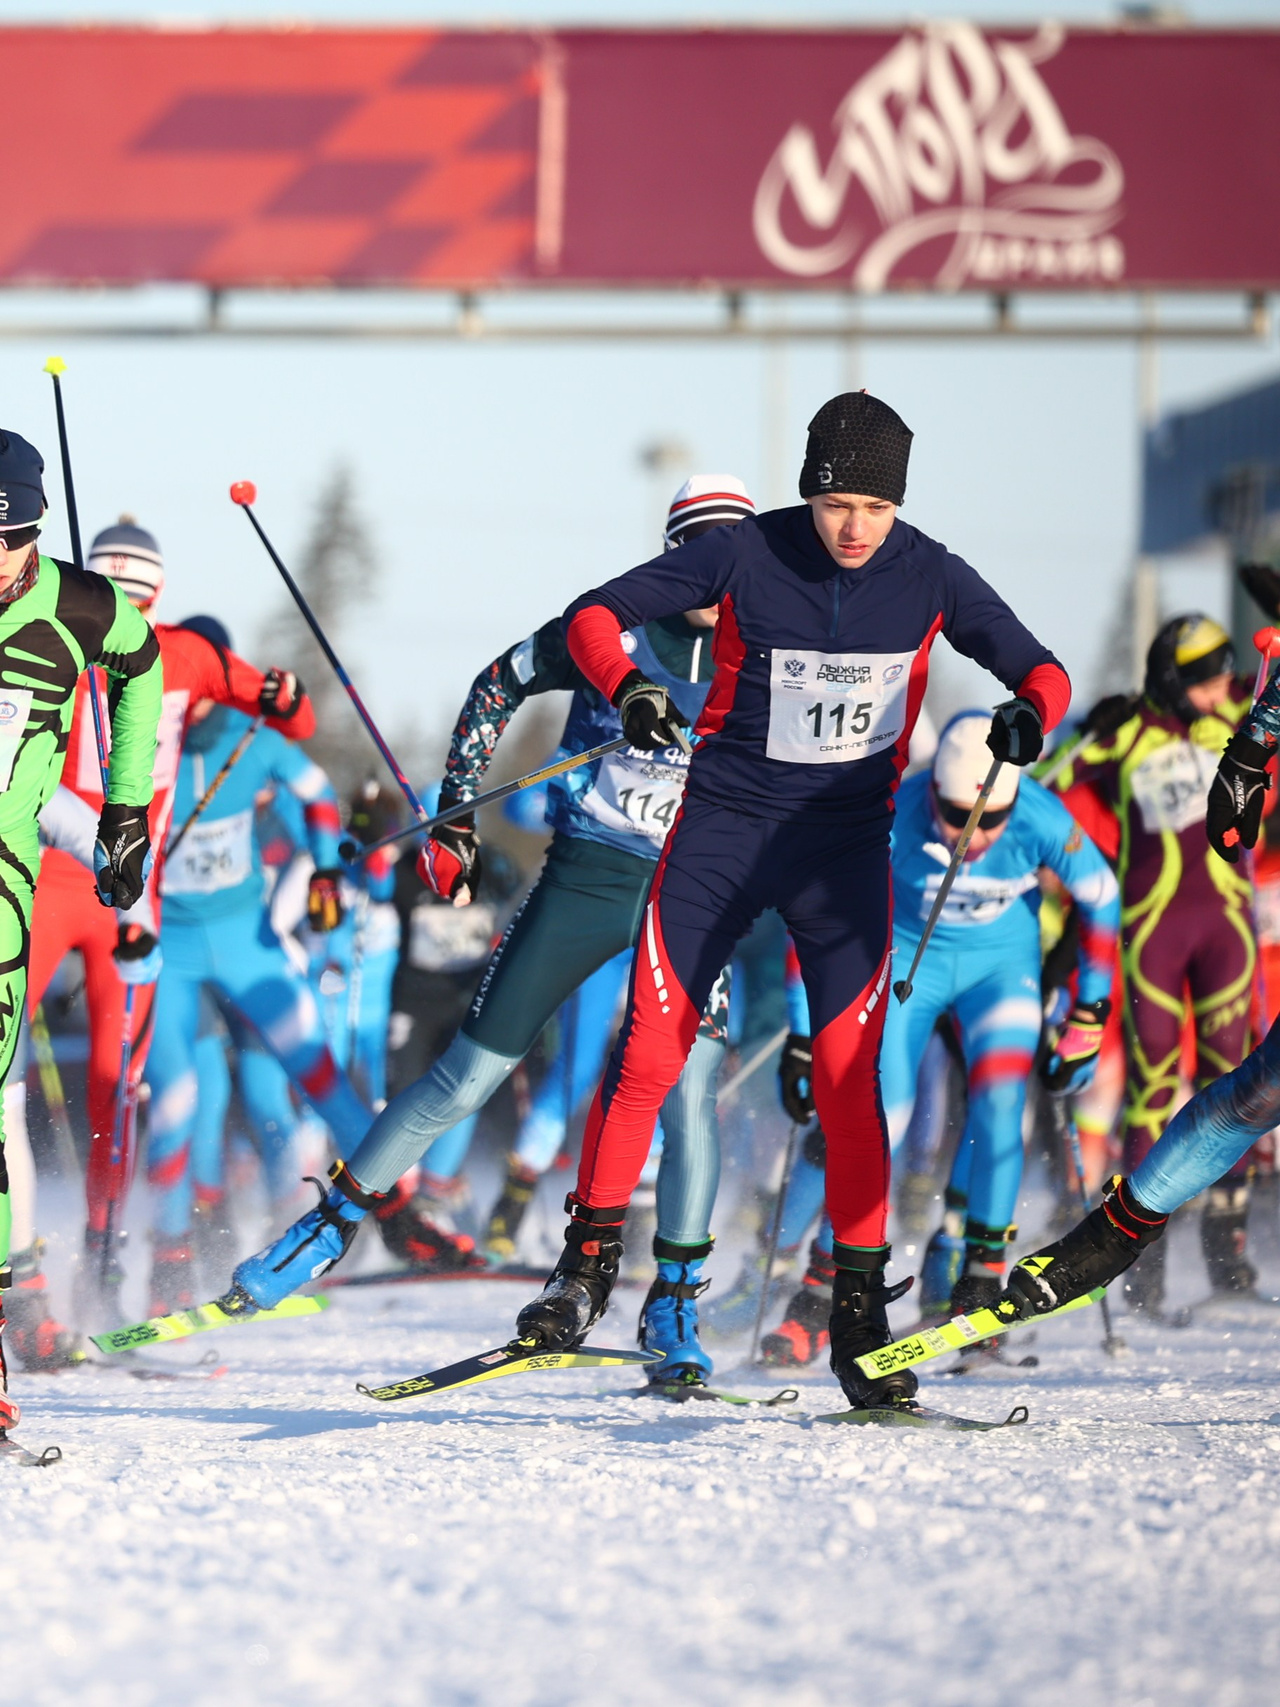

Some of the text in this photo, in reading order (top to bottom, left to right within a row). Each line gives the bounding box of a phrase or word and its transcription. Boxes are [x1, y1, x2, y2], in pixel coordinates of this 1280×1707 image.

[816, 672, 872, 684] РОССИИ
[819, 663, 871, 675] ЛЫЖНЯ
[807, 701, 873, 738] 115
[819, 730, 898, 752] САНКТ-ПЕТЕРБУРГ
[619, 788, 677, 828] 114
[524, 1354, 563, 1370] FISCHER
[876, 1338, 926, 1372] FISCHER
